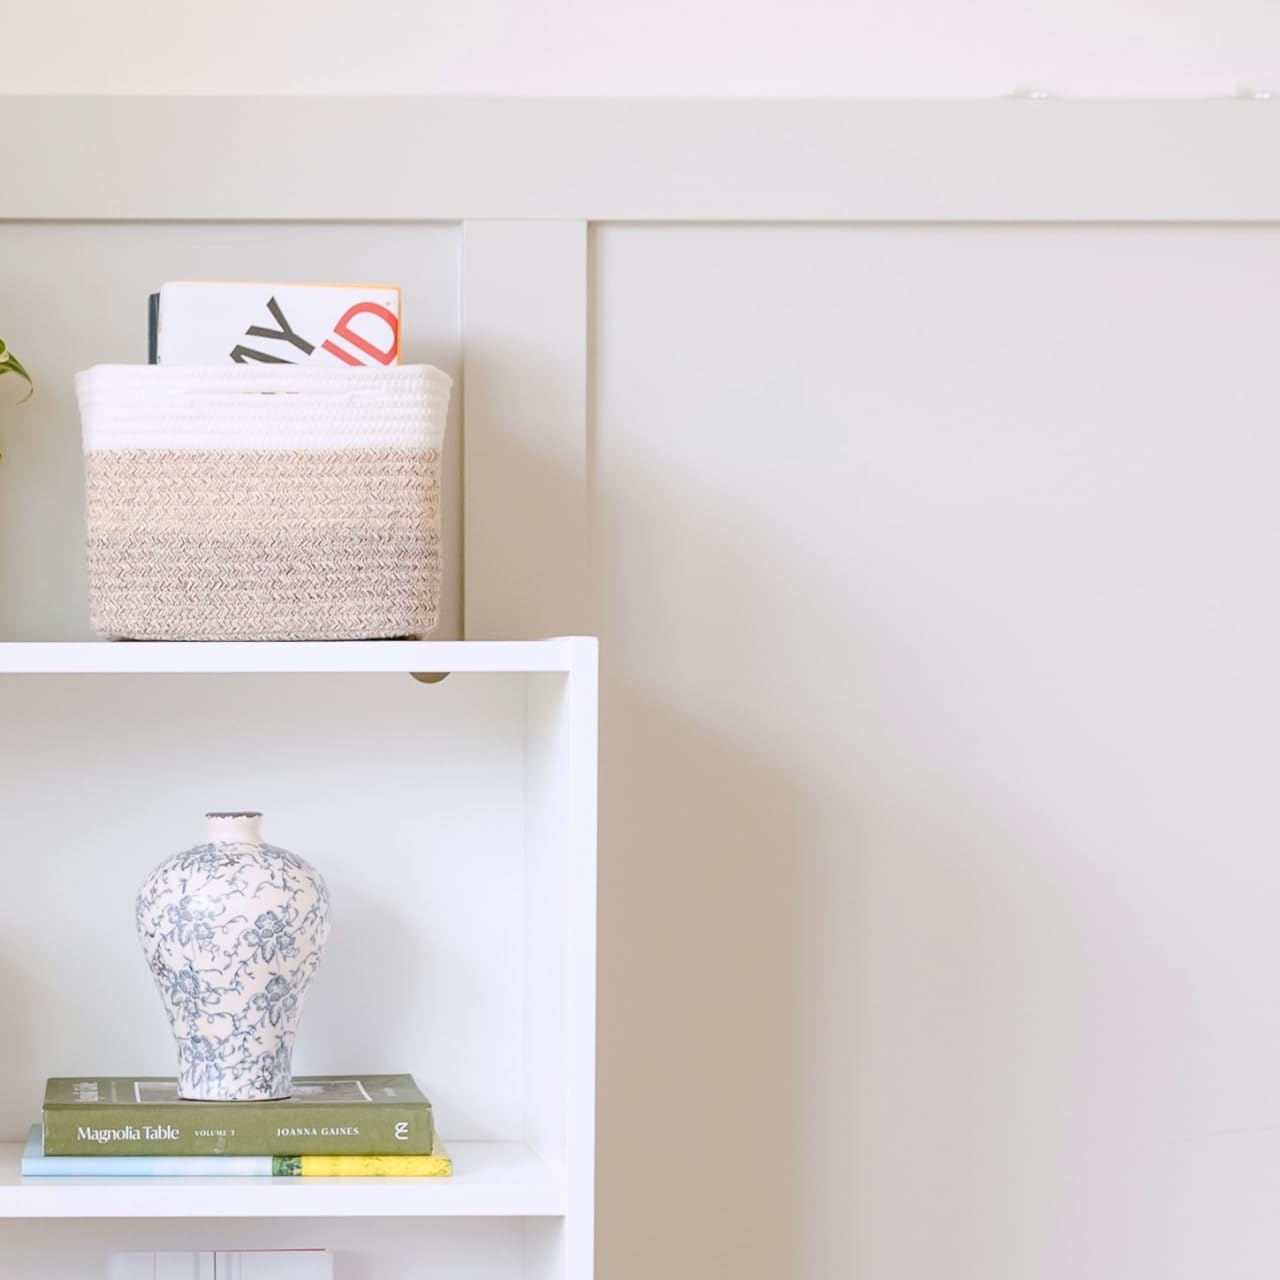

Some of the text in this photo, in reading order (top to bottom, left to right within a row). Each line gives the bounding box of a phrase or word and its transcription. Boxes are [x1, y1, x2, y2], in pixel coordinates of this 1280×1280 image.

[77, 1125, 141, 1144] Magnolia
[142, 1125, 180, 1140] Table
[194, 1129, 227, 1137] VOLUME
[277, 1127, 318, 1137] JOANNA
[320, 1126, 360, 1136] GAINES
